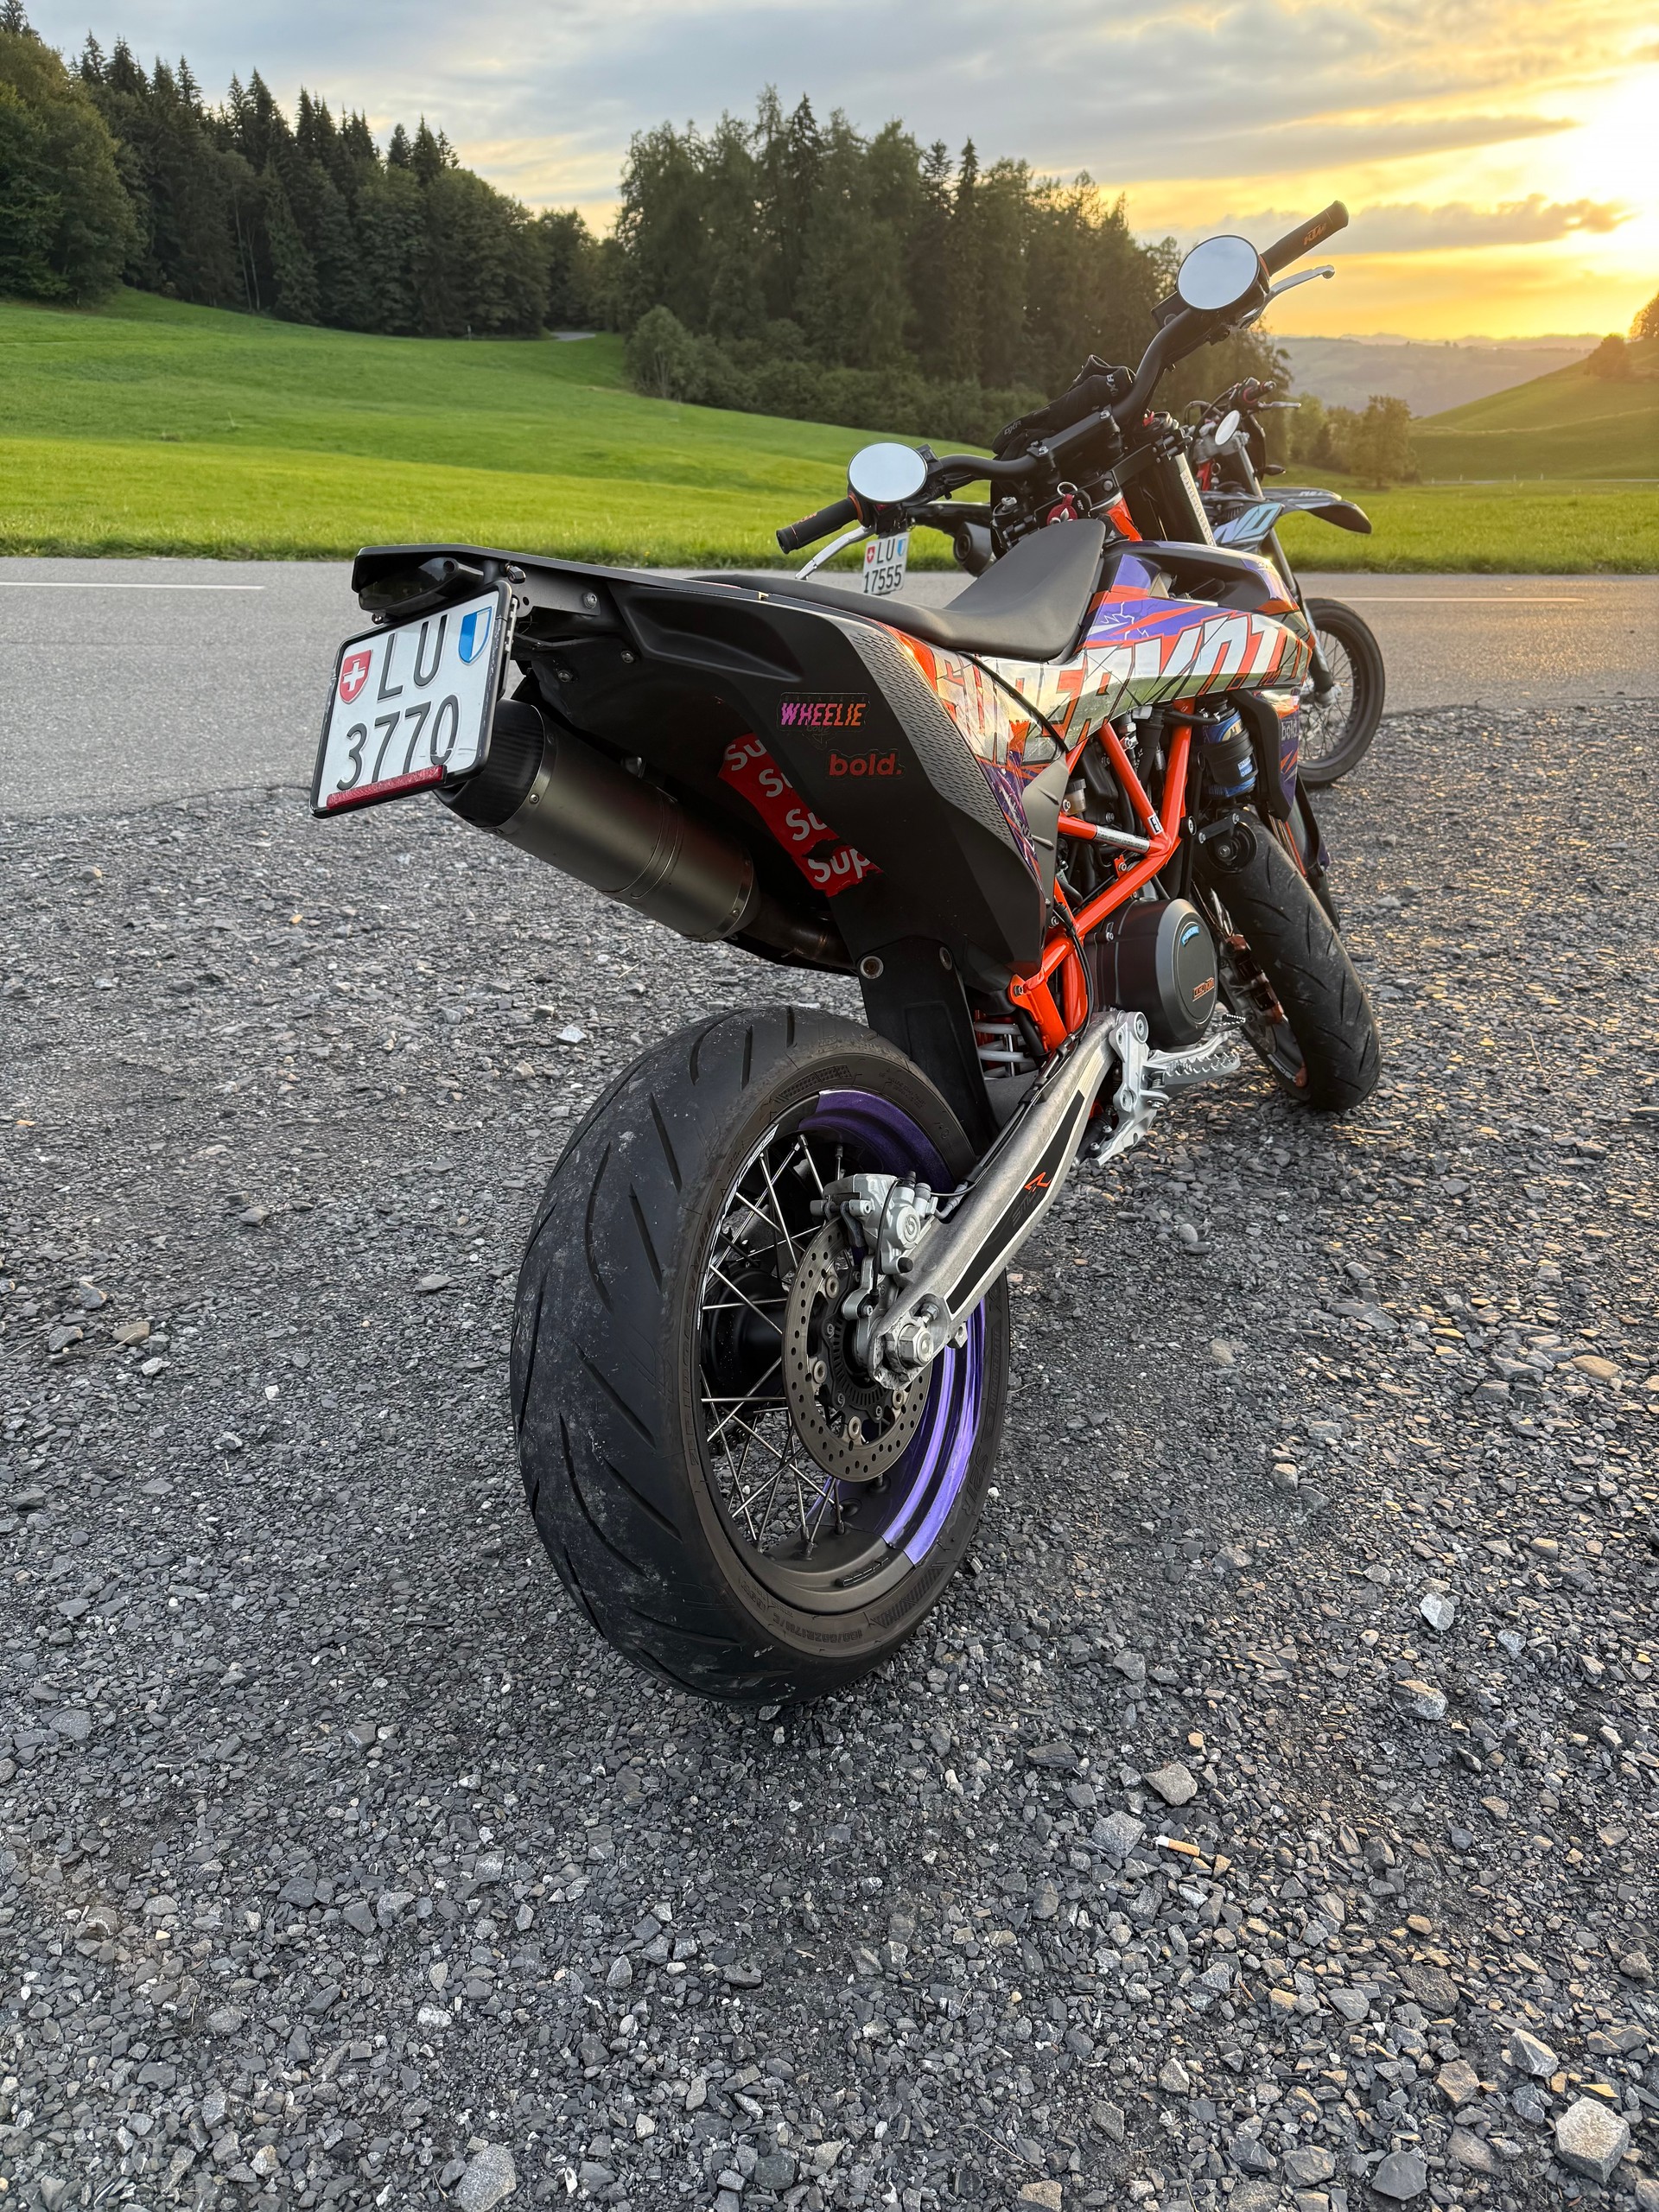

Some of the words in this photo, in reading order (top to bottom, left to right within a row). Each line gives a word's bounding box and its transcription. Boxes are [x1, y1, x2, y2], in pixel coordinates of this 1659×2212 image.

[877, 538, 896, 564] LU
[863, 563, 903, 594] 17555
[378, 613, 448, 701] LU
[781, 702, 867, 726] WHEELIE
[336, 694, 459, 791] 3770
[829, 753, 903, 776] bold.
